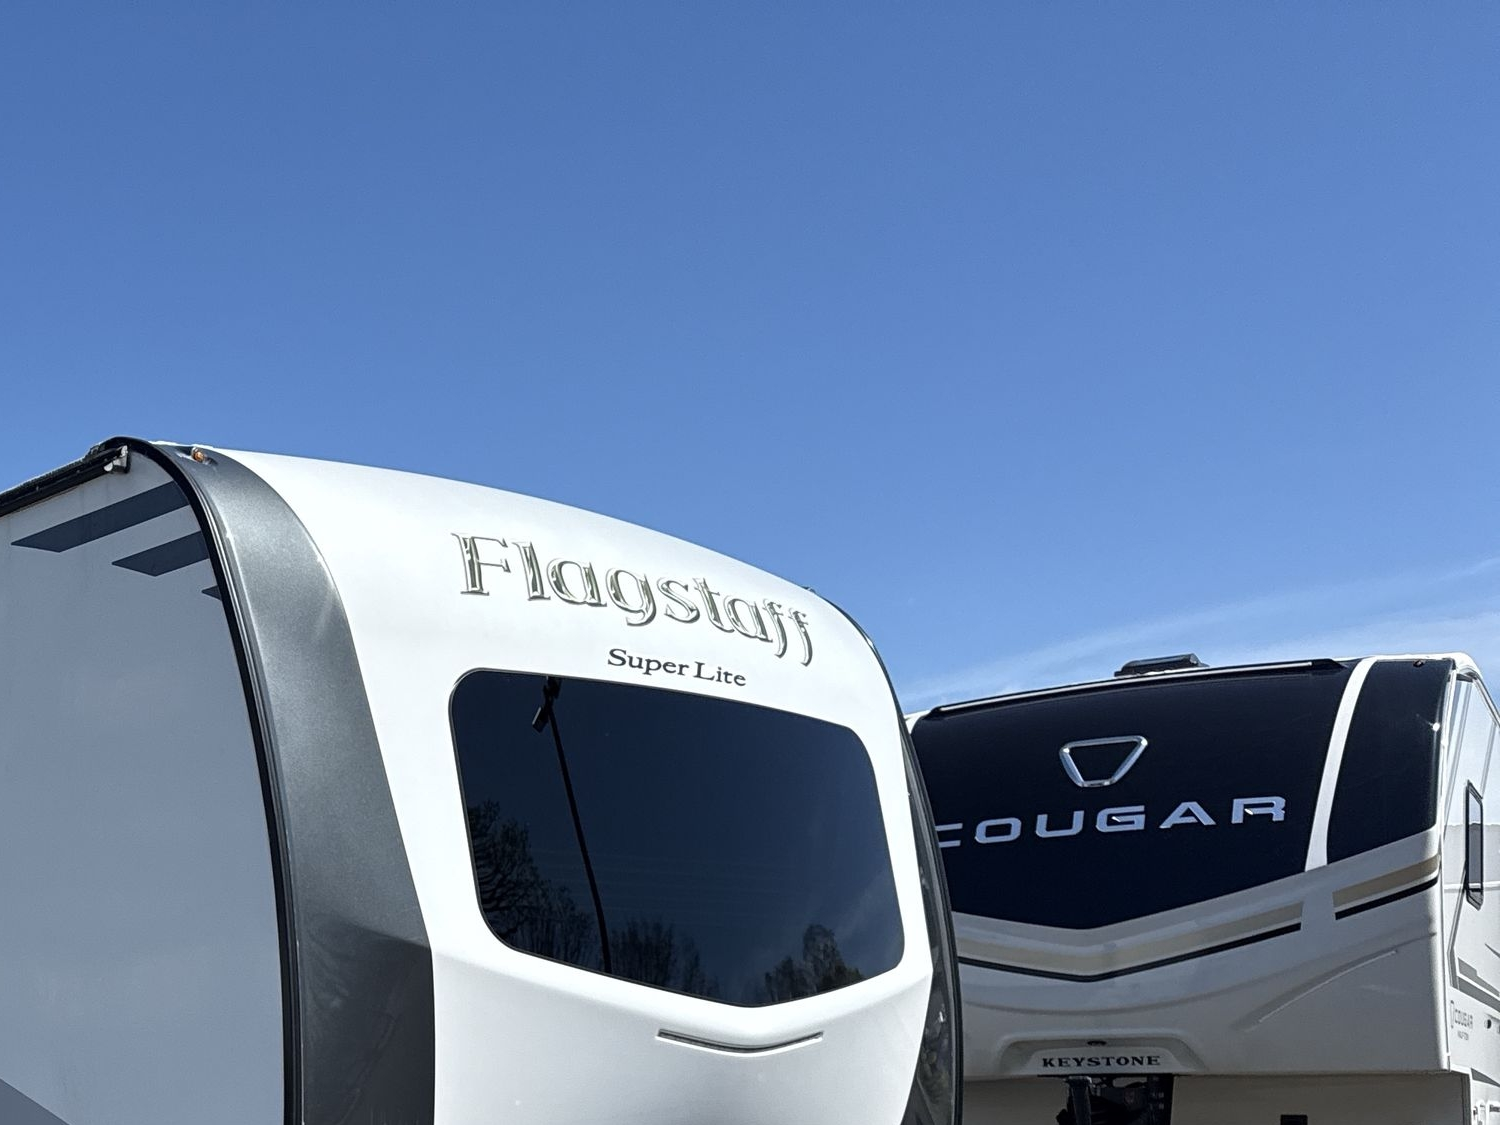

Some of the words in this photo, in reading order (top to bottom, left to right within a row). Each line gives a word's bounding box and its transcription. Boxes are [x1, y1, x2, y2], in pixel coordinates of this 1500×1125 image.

[451, 532, 813, 666] Flagstaff
[607, 648, 690, 675] Super
[693, 661, 747, 686] Lite
[1041, 1055, 1161, 1068] KEYSTONE
